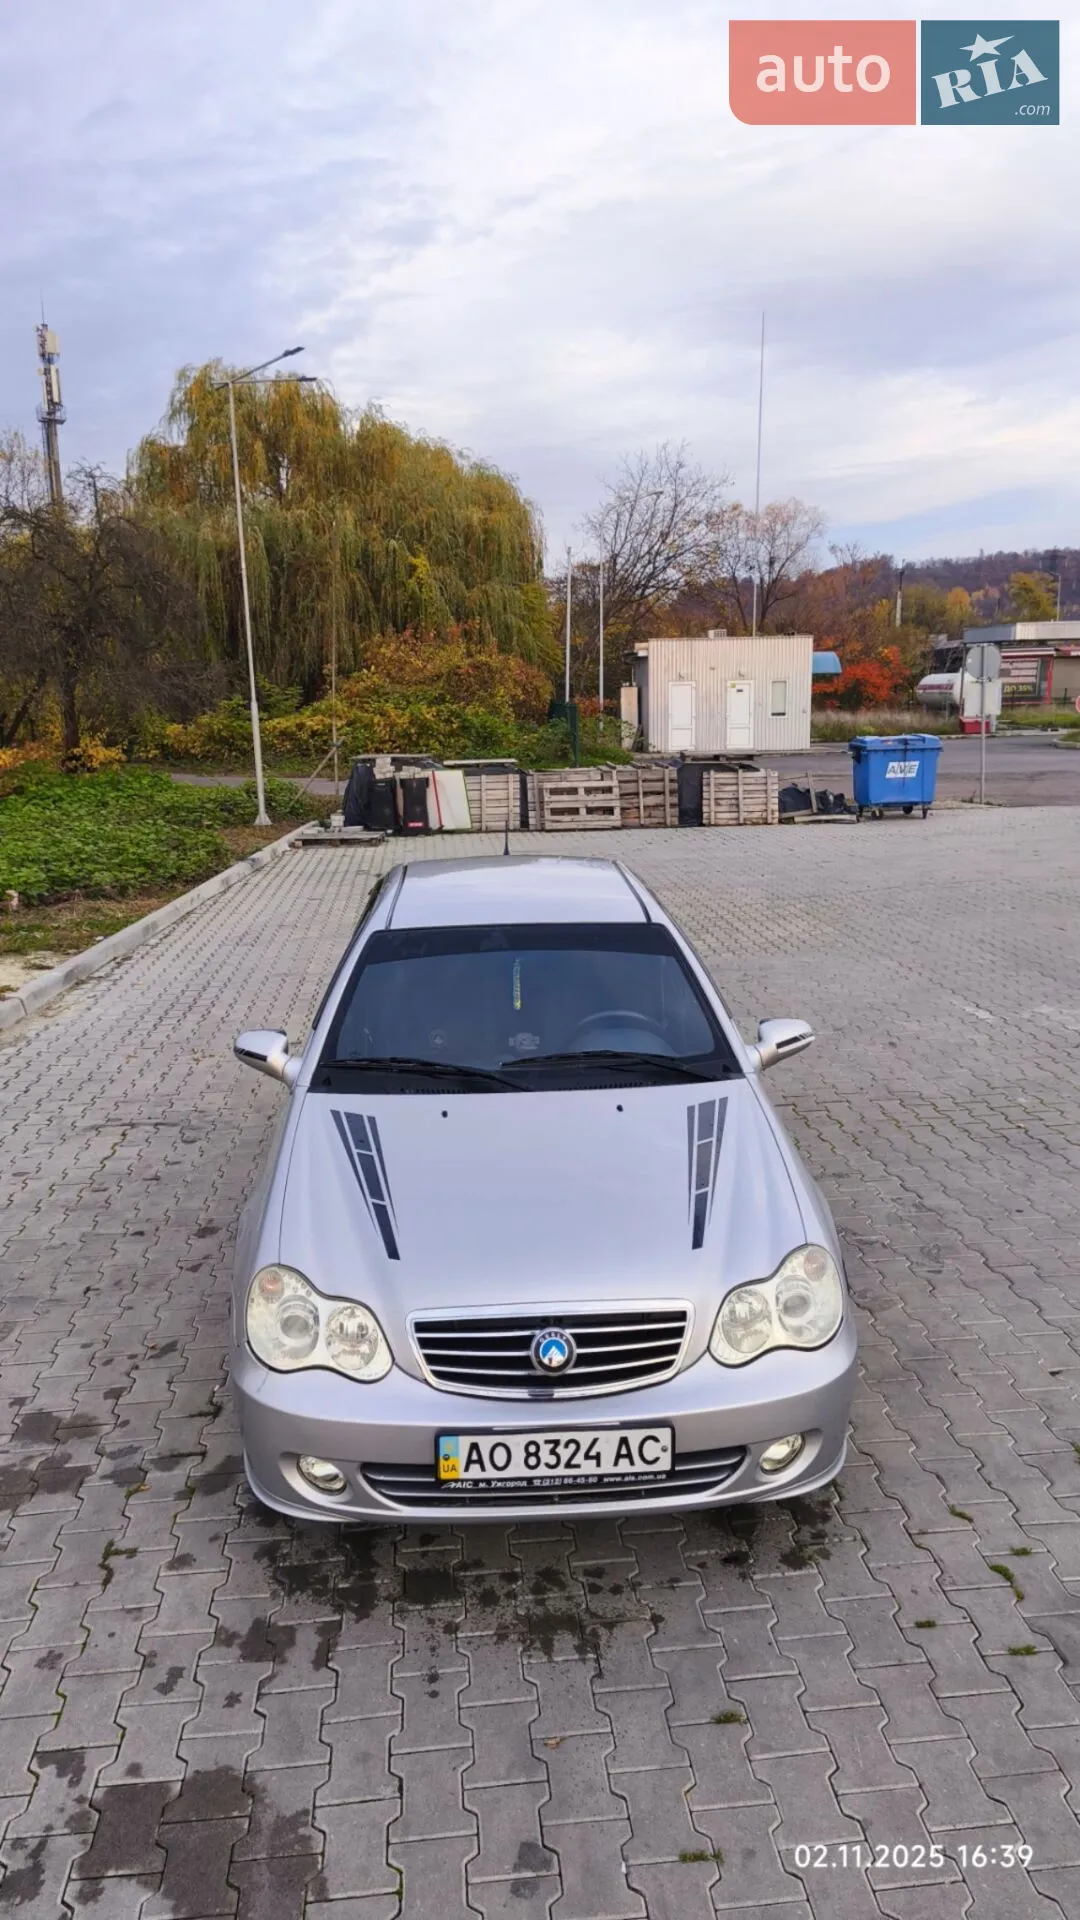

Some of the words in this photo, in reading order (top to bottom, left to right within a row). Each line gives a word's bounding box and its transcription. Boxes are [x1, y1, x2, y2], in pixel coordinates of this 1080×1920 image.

[463, 1442, 512, 1473] AO
[523, 1437, 602, 1471] 8324
[612, 1434, 662, 1468] AC
[442, 1462, 458, 1474] UA
